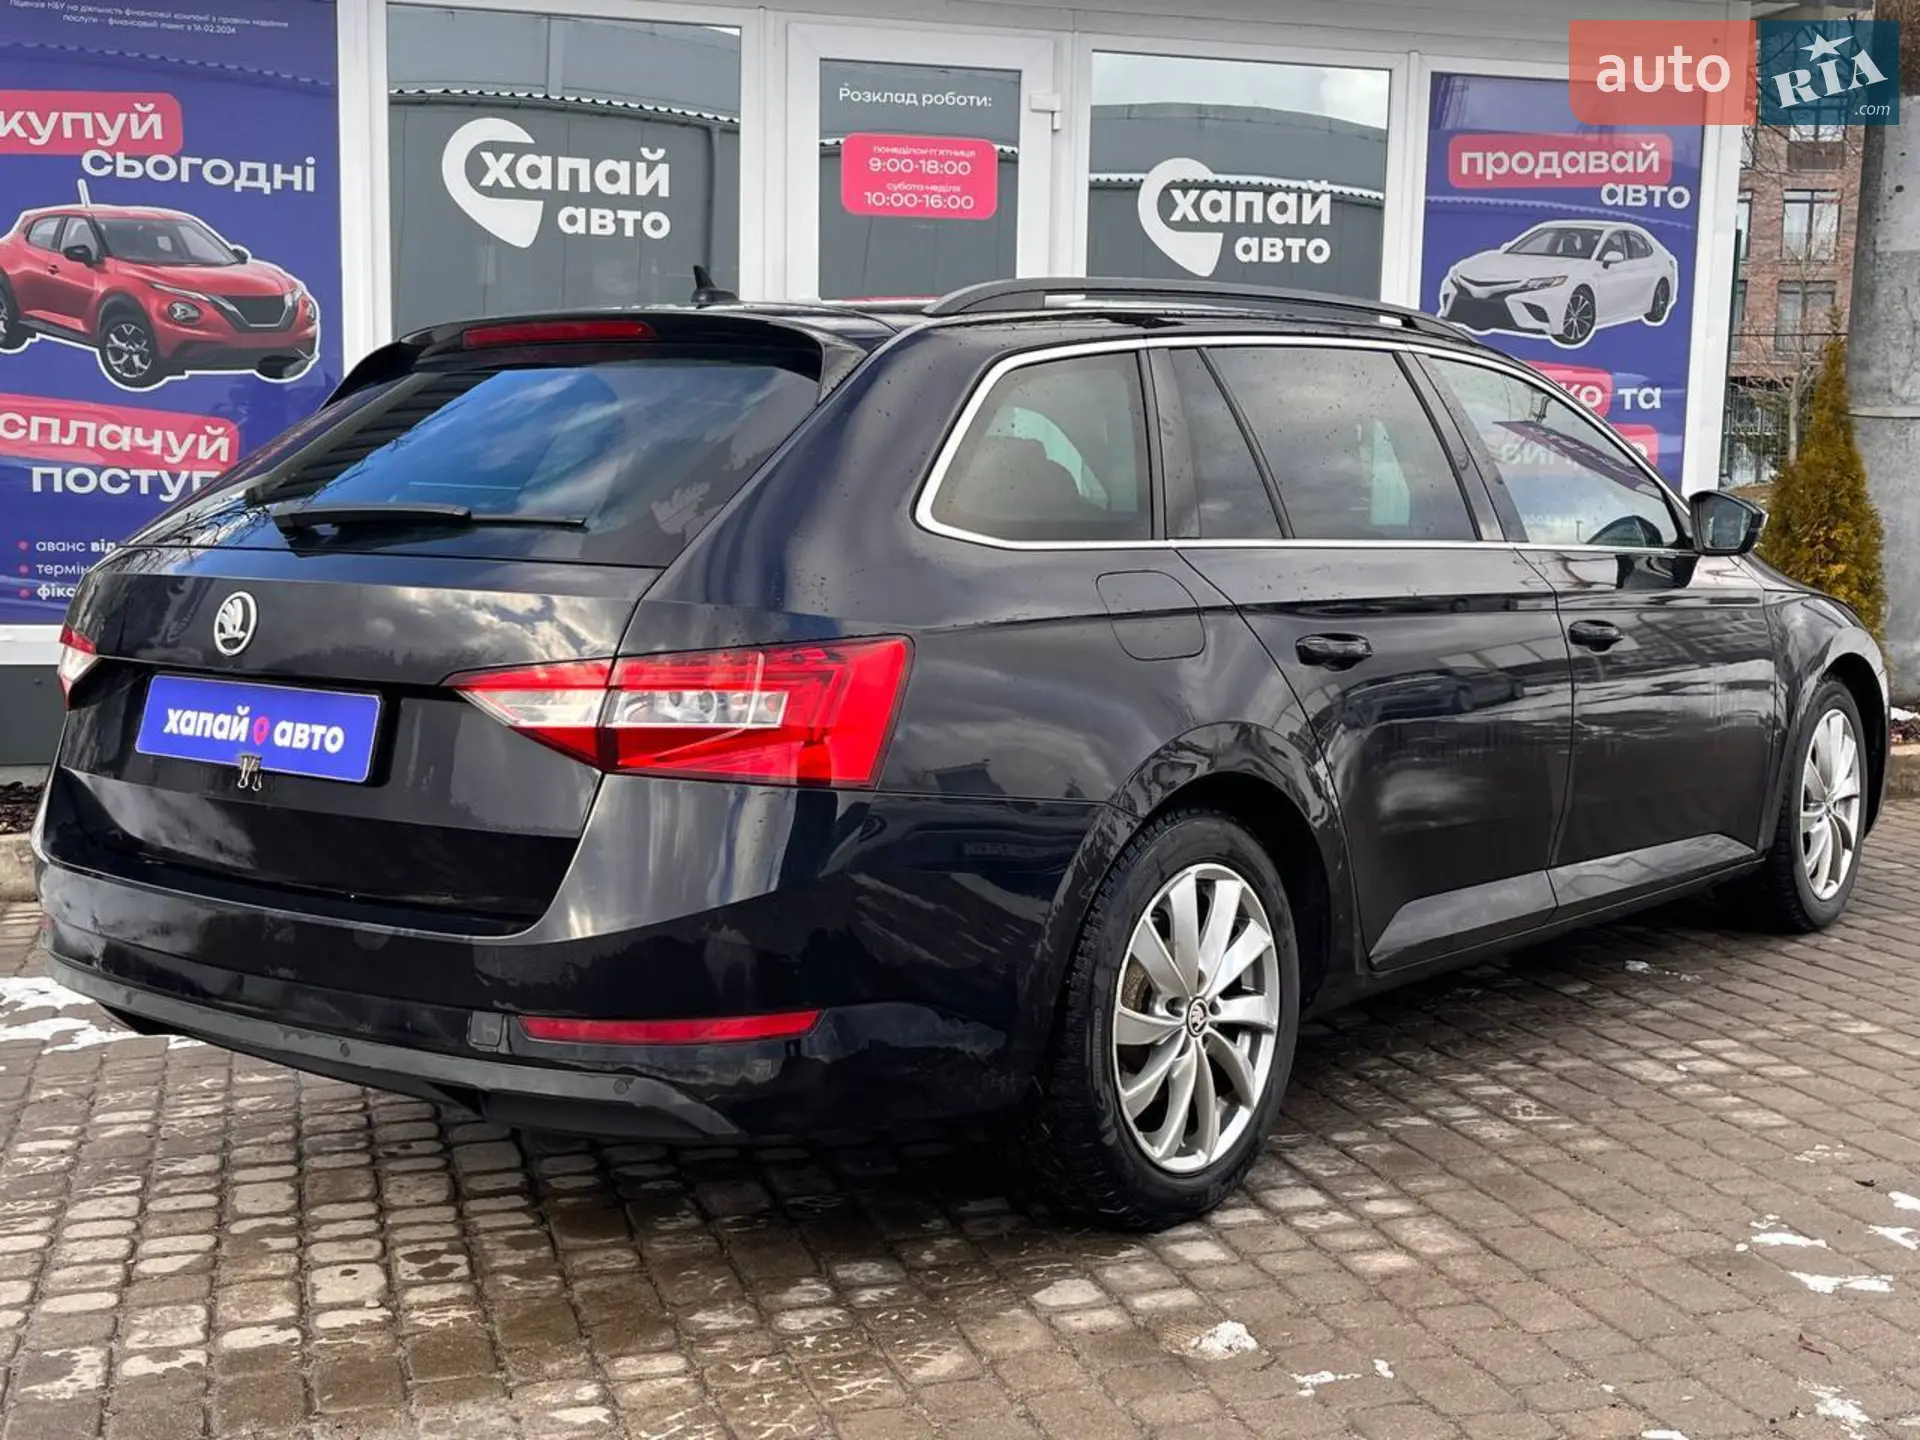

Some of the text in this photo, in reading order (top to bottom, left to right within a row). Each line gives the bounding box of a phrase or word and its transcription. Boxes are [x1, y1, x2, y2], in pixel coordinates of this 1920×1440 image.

[839, 86, 992, 107] Розклад роботи:
[82, 149, 316, 194] сьогодні
[479, 147, 670, 198] хапай
[868, 157, 972, 175] 9:00-18:00
[1461, 142, 1659, 181] продавай
[864, 191, 974, 209] 10:00-16:00
[1169, 180, 1331, 225] хапай
[1601, 183, 1690, 209] авто
[557, 206, 671, 239] авто
[1235, 236, 1331, 263] авто
[1618, 387, 1661, 410] та
[0, 412, 230, 463] сплачуй
[36, 541, 86, 552] аванс
[163, 705, 345, 753] хапай авто
